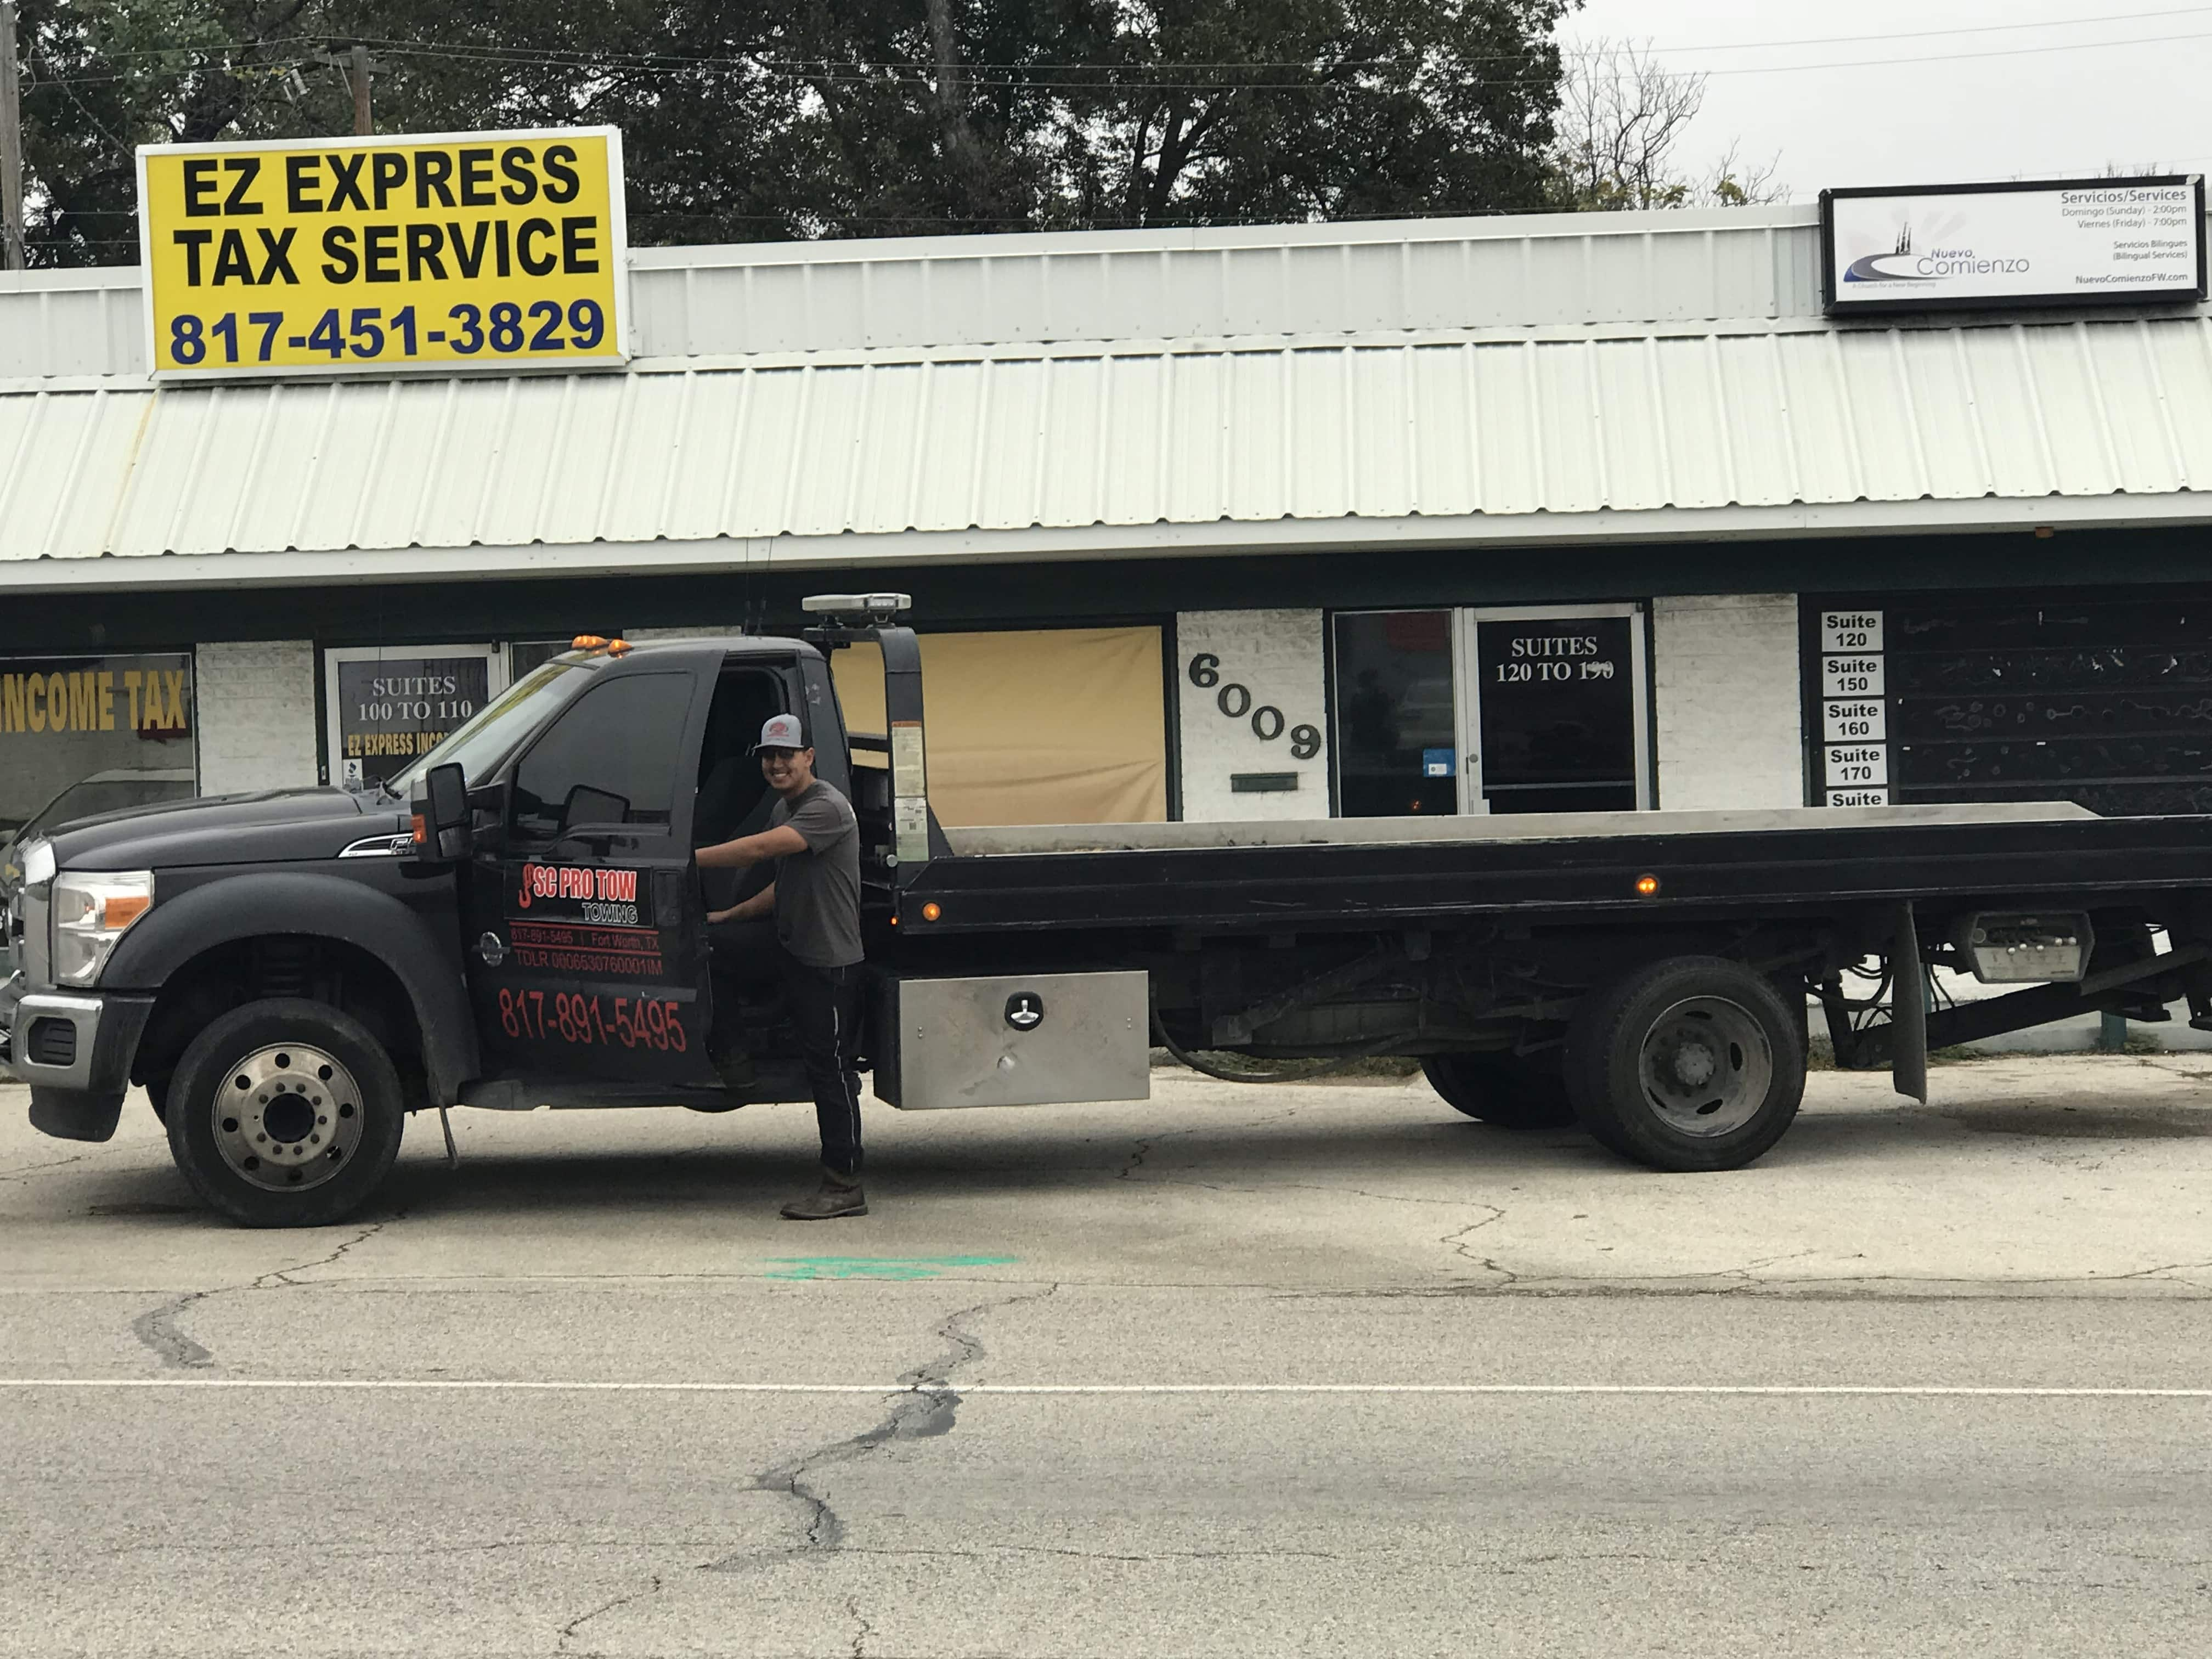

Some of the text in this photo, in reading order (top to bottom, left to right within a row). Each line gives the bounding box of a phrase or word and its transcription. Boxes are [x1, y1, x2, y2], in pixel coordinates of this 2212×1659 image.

[183, 145, 580, 217] EZ EXPRESS
[2061, 189, 2186, 204] Servicios/Services
[2062, 207, 2104, 217] Domingo
[2106, 206, 2146, 216] (Sunday)
[2153, 205, 2187, 215] 2:00pm
[2112, 219, 2146, 228] (Friday)
[2154, 217, 2187, 227] 7:00pm
[173, 216, 600, 286] TAX SERVICE
[1931, 249, 1973, 259] Nuevo
[2113, 250, 2188, 261] (Bilingual Services)
[1917, 256, 2029, 275] Comienzo
[2075, 273, 2188, 284] NuevoComienzoFW.com
[170, 298, 605, 365] 817-451-3829
[1827, 614, 1876, 629] Suite
[1511, 636, 1598, 657] SUITES
[1836, 633, 1867, 646] 120
[1497, 663, 1532, 682] 120
[1537, 662, 1572, 681] TO
[1827, 659, 1877, 673] Suite
[373, 676, 456, 696] SUITES
[1837, 677, 1868, 691] 150
[0, 670, 186, 732] NCOME TAX
[359, 699, 472, 721] 100 TO 110
[1189, 653, 1321, 759] 6009
[1829, 704, 1878, 718] Suite
[1838, 721, 1869, 736] 160
[348, 735, 362, 756] EZ
[365, 733, 413, 755] EXPRESS
[1831, 748, 1880, 763] Suite
[1841, 766, 1871, 780] 170
[1832, 793, 1882, 807] Suite
[559, 867, 594, 899] PRO
[595, 870, 637, 902] TOW
[582, 902, 639, 924] TOWING
[591, 932, 611, 947] Fort
[645, 936, 659, 950] TX
[515, 949, 549, 968] TDLR
[499, 988, 686, 1052] 817-891-5495
